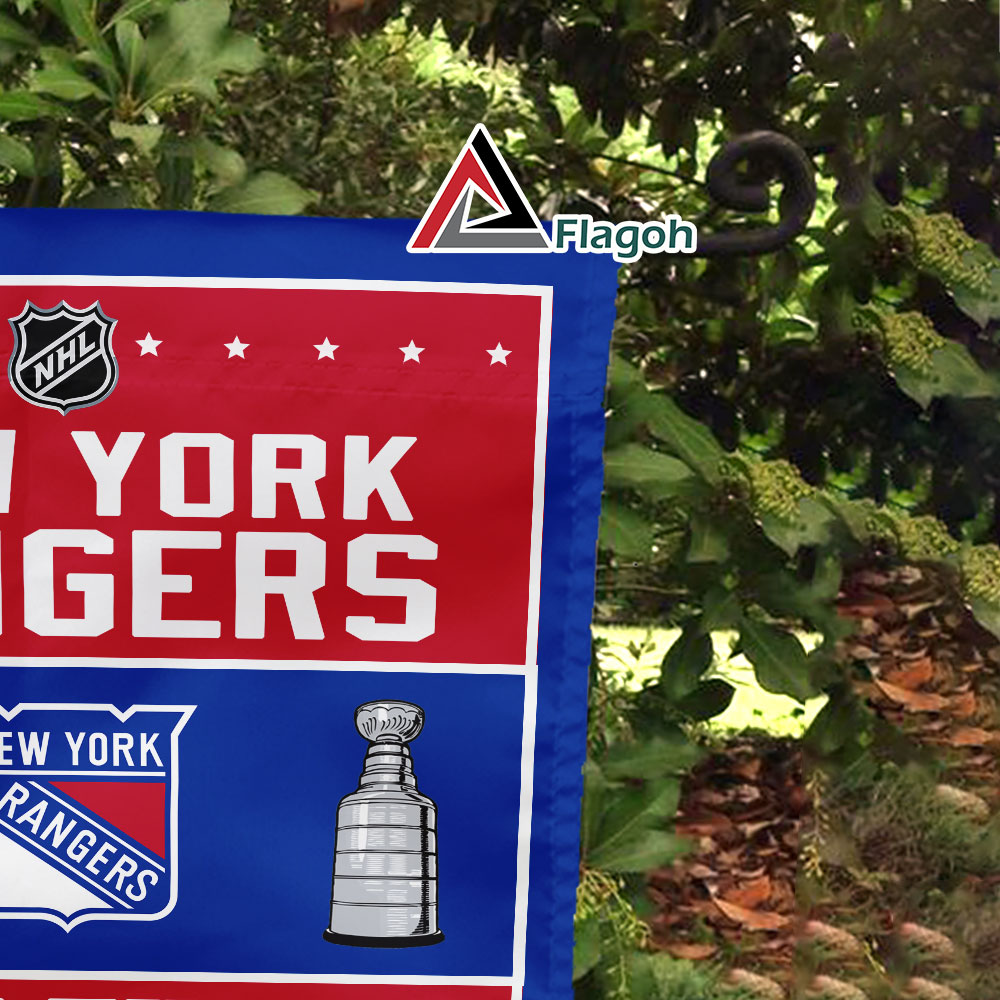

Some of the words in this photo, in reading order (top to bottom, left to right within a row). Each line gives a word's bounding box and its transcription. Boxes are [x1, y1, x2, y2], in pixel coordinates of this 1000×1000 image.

[33, 331, 96, 389] NHL
[71, 431, 417, 522] YORK
[64, 731, 164, 768] YORK
